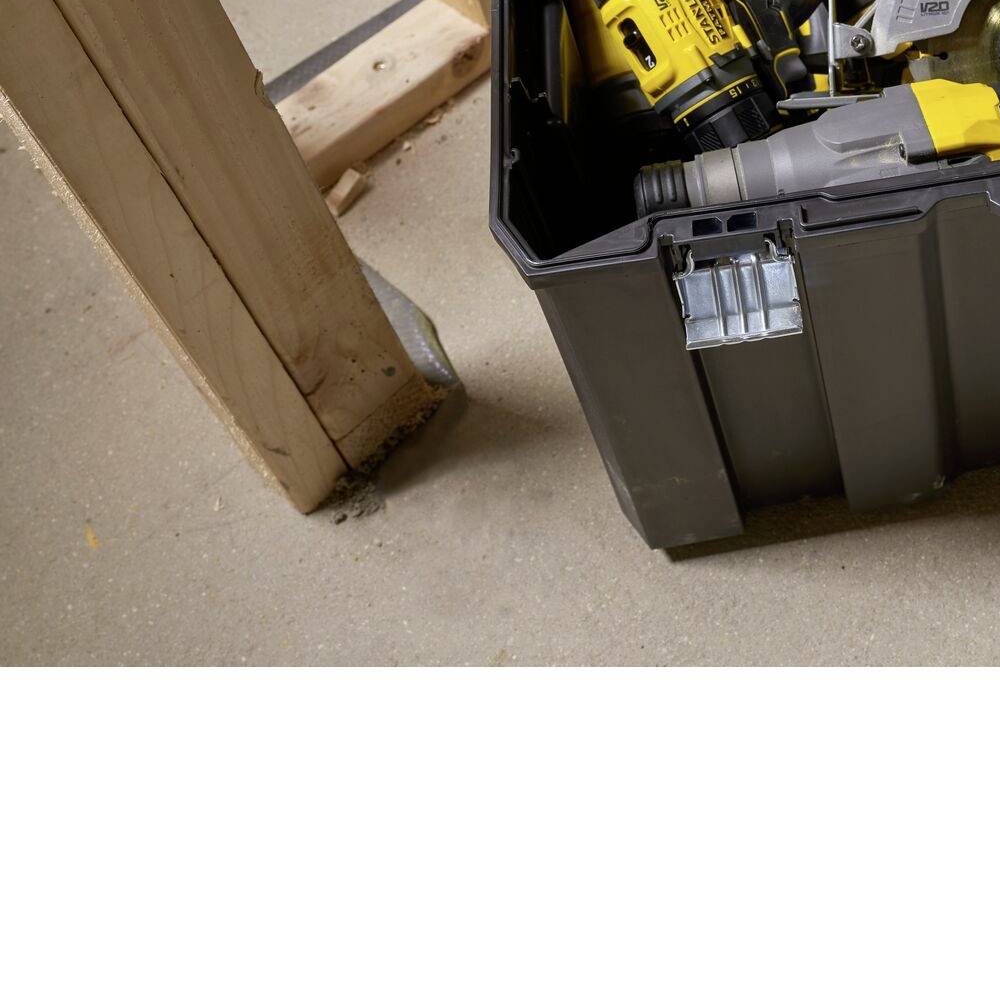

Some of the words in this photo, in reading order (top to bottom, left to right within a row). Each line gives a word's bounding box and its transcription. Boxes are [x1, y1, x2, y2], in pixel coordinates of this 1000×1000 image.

[920, 0, 950, 13] V20
[644, 56, 656, 68] 2
[728, 86, 742, 99] 15
